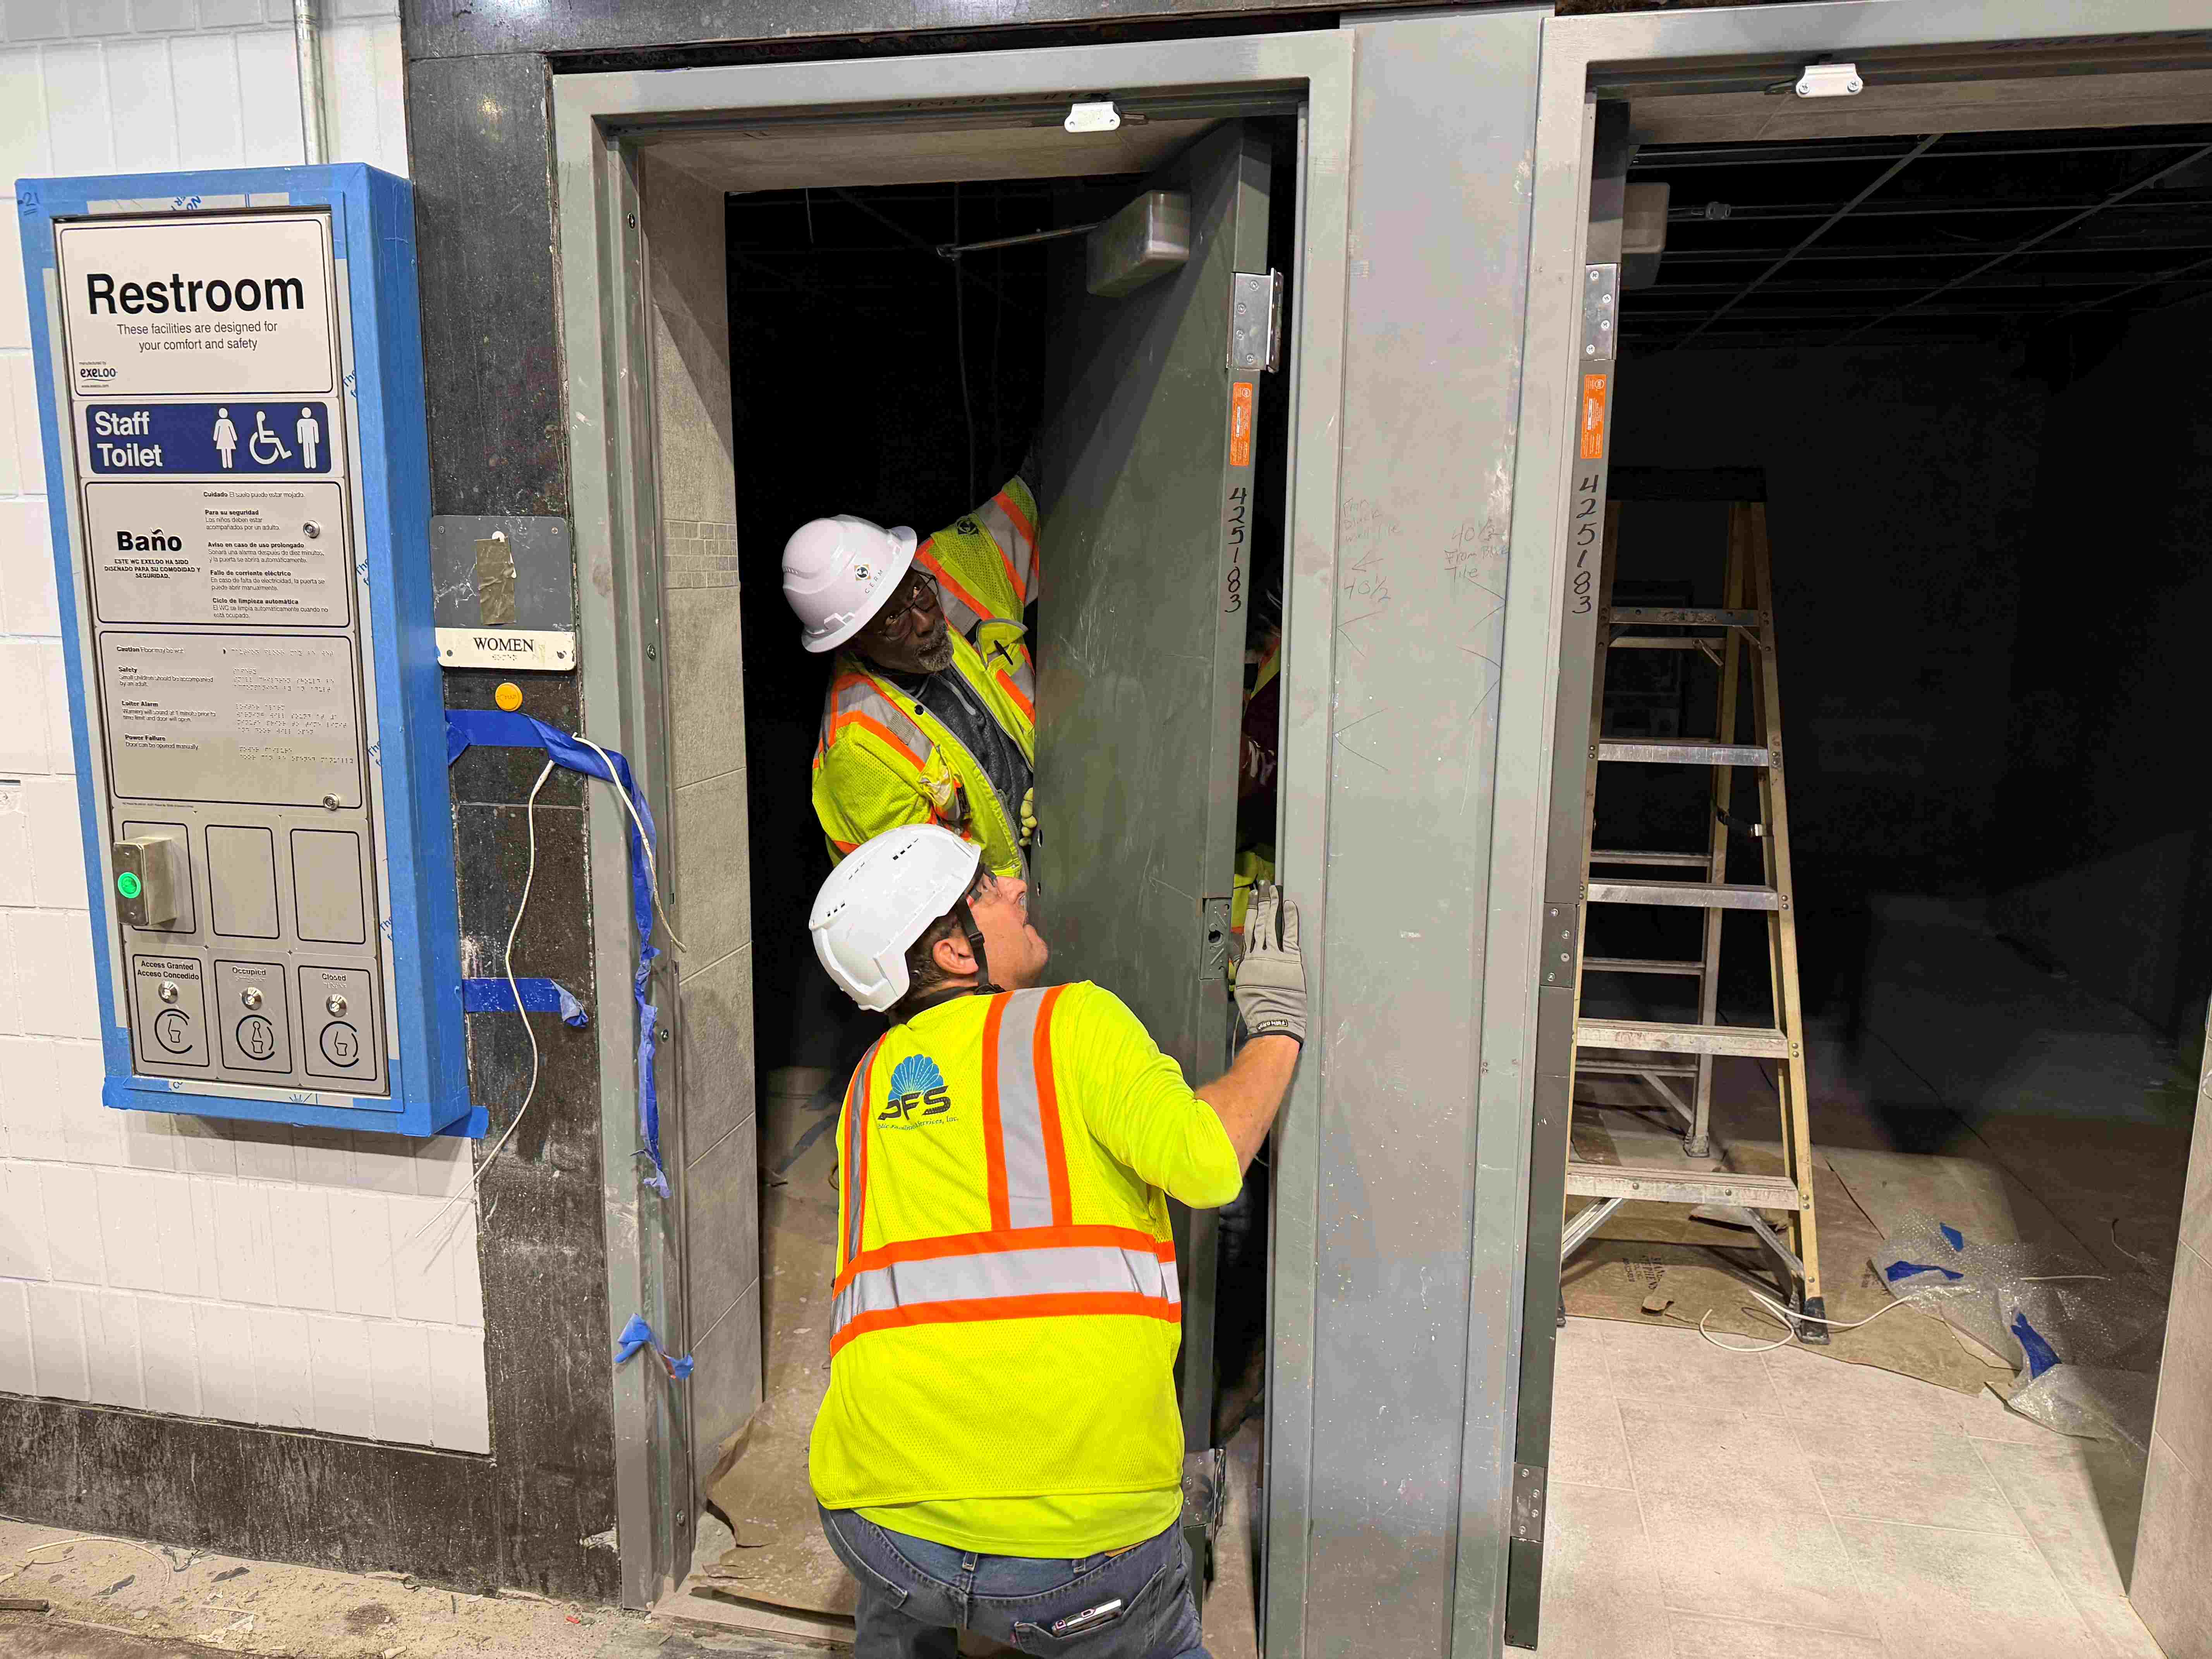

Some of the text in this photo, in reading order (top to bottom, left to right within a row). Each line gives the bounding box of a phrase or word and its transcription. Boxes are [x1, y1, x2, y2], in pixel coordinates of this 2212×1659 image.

[87, 273, 304, 315] Restroom
[117, 321, 278, 335] These facilities are designed for
[139, 338, 258, 352] your comfort and safety
[95, 410, 150, 436] Staff
[97, 443, 163, 467] Toilet
[117, 529, 182, 551] Baño
[865, 570, 883, 593] CERM
[474, 637, 534, 652] WOMEN
[141, 960, 193, 970] Access Granted
[232, 967, 266, 975] Occupied
[137, 969, 199, 980] Acceso Concedido
[322, 973, 346, 981] Closed
